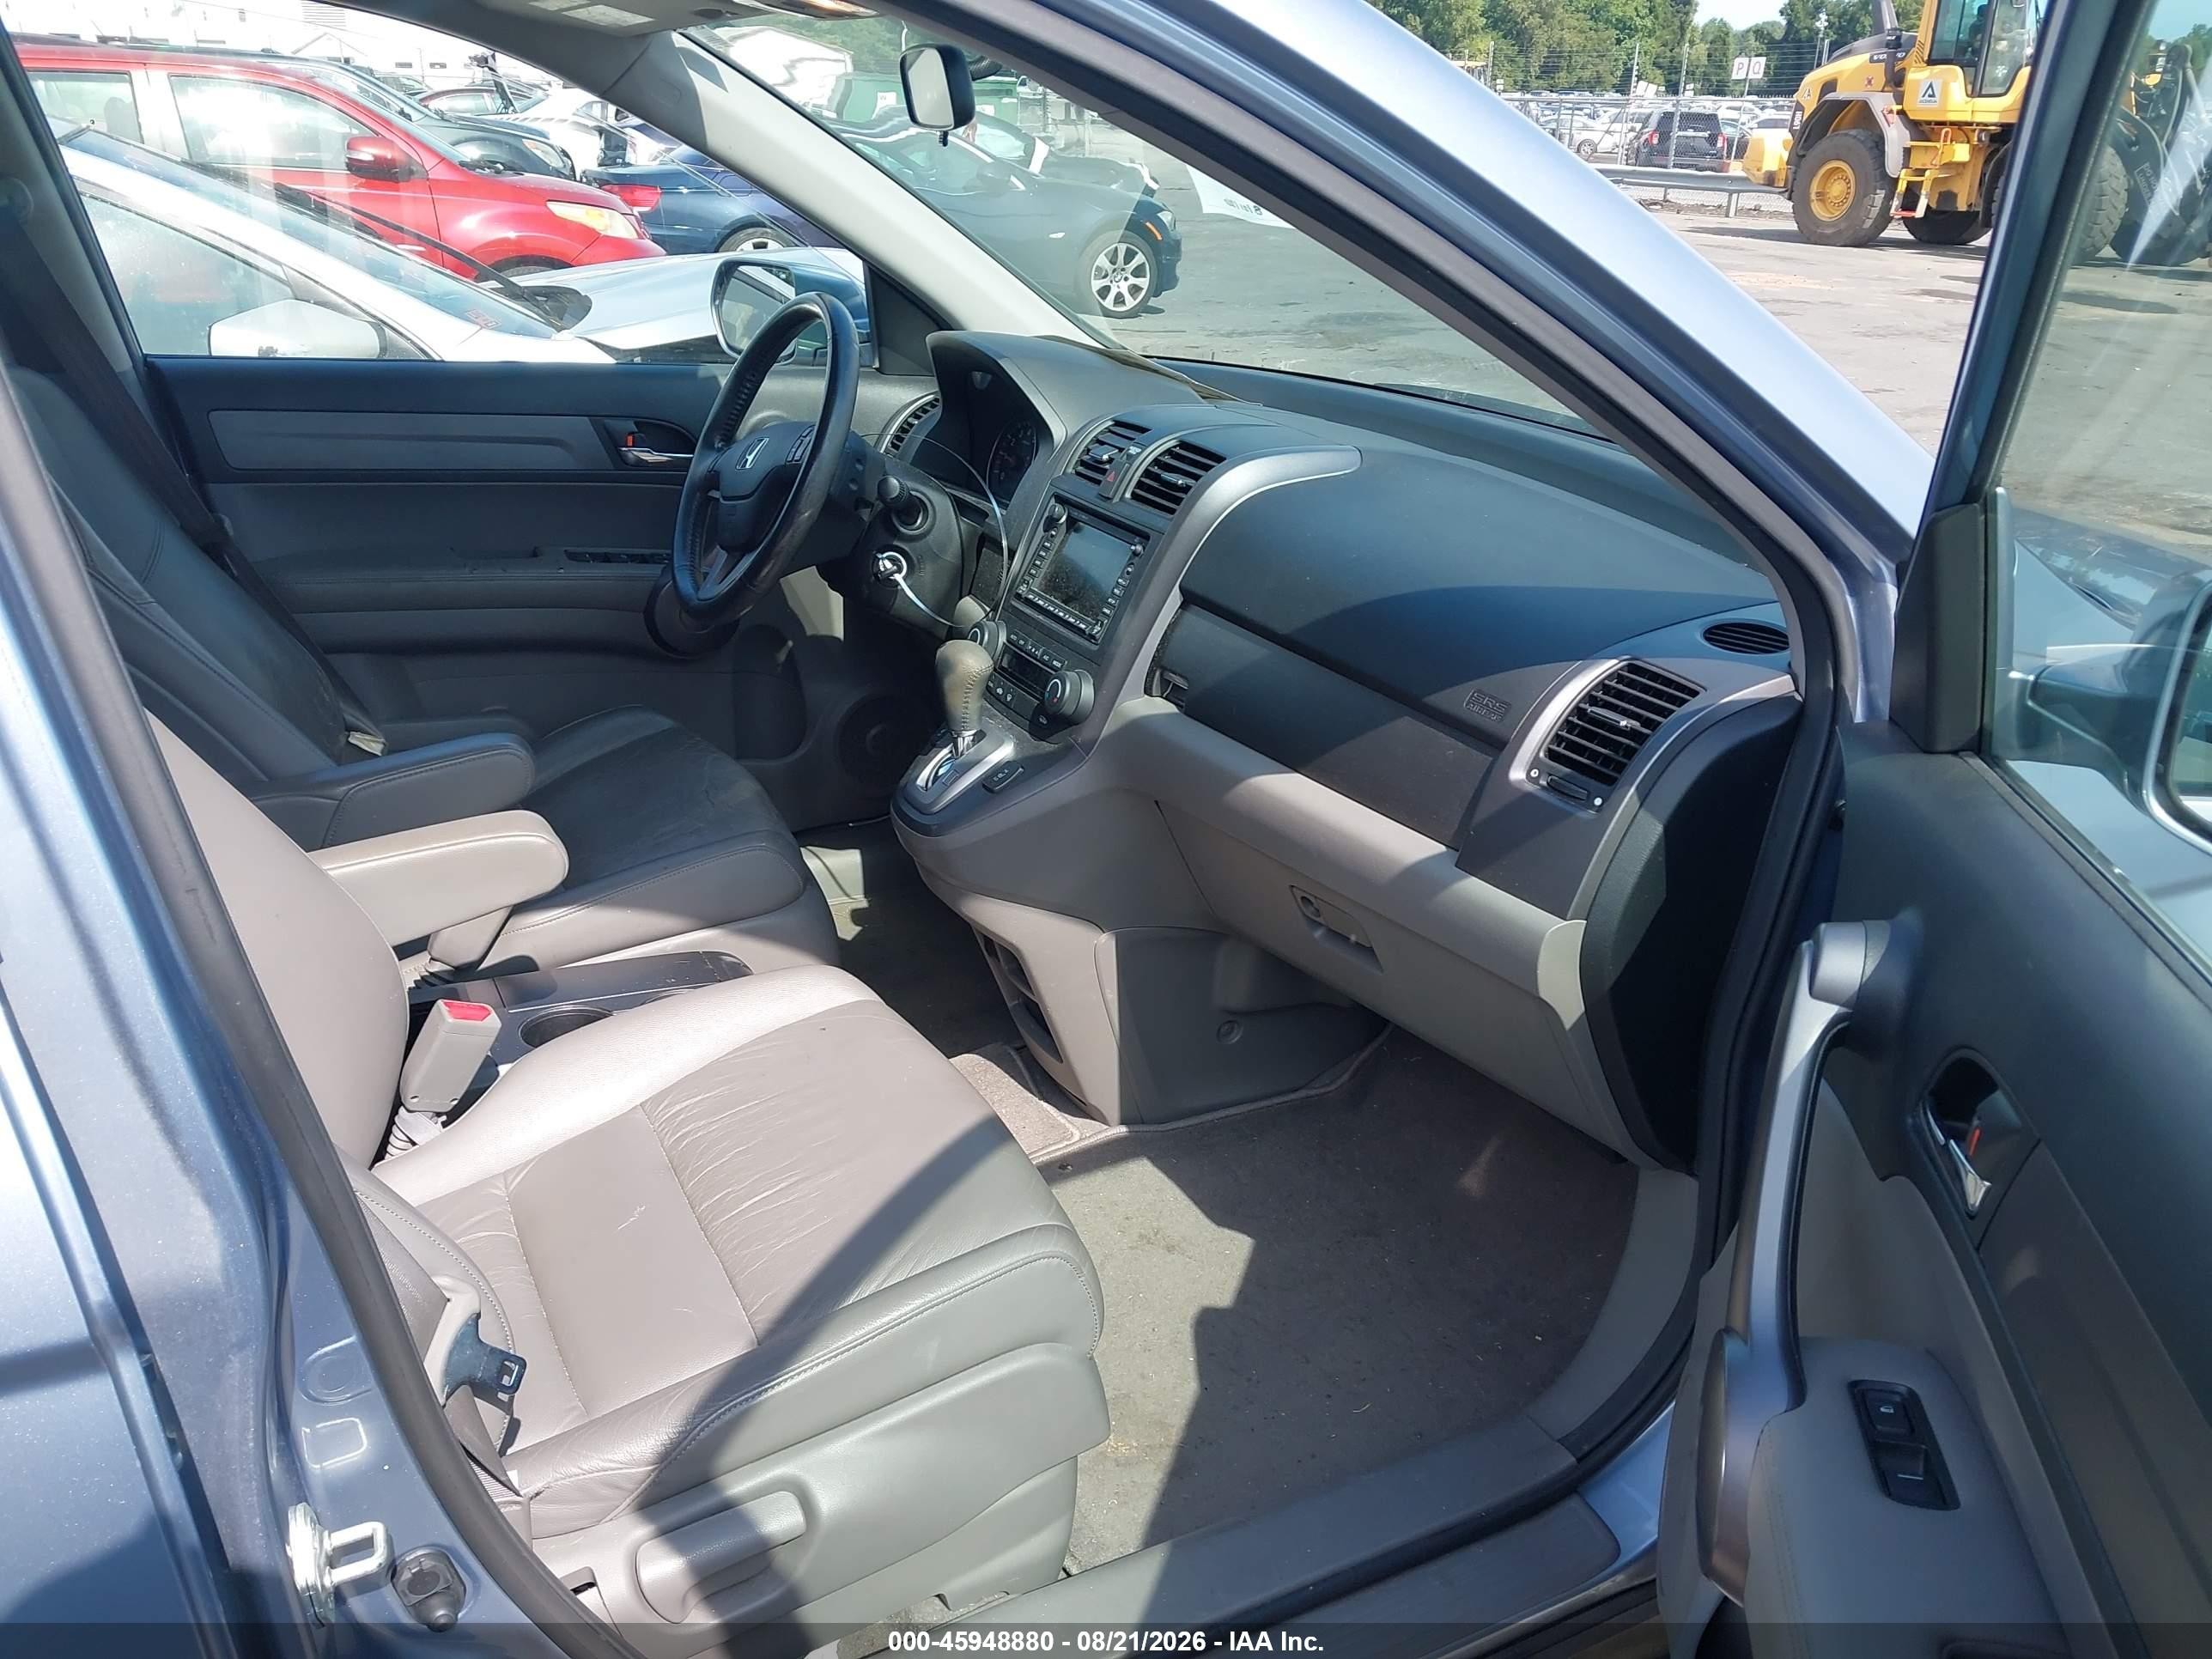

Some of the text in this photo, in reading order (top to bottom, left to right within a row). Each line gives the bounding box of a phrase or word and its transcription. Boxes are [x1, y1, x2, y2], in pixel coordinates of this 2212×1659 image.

[1736, 62, 1744, 76] P
[1753, 61, 1761, 75] Q
[1471, 692, 1509, 714] SRS
